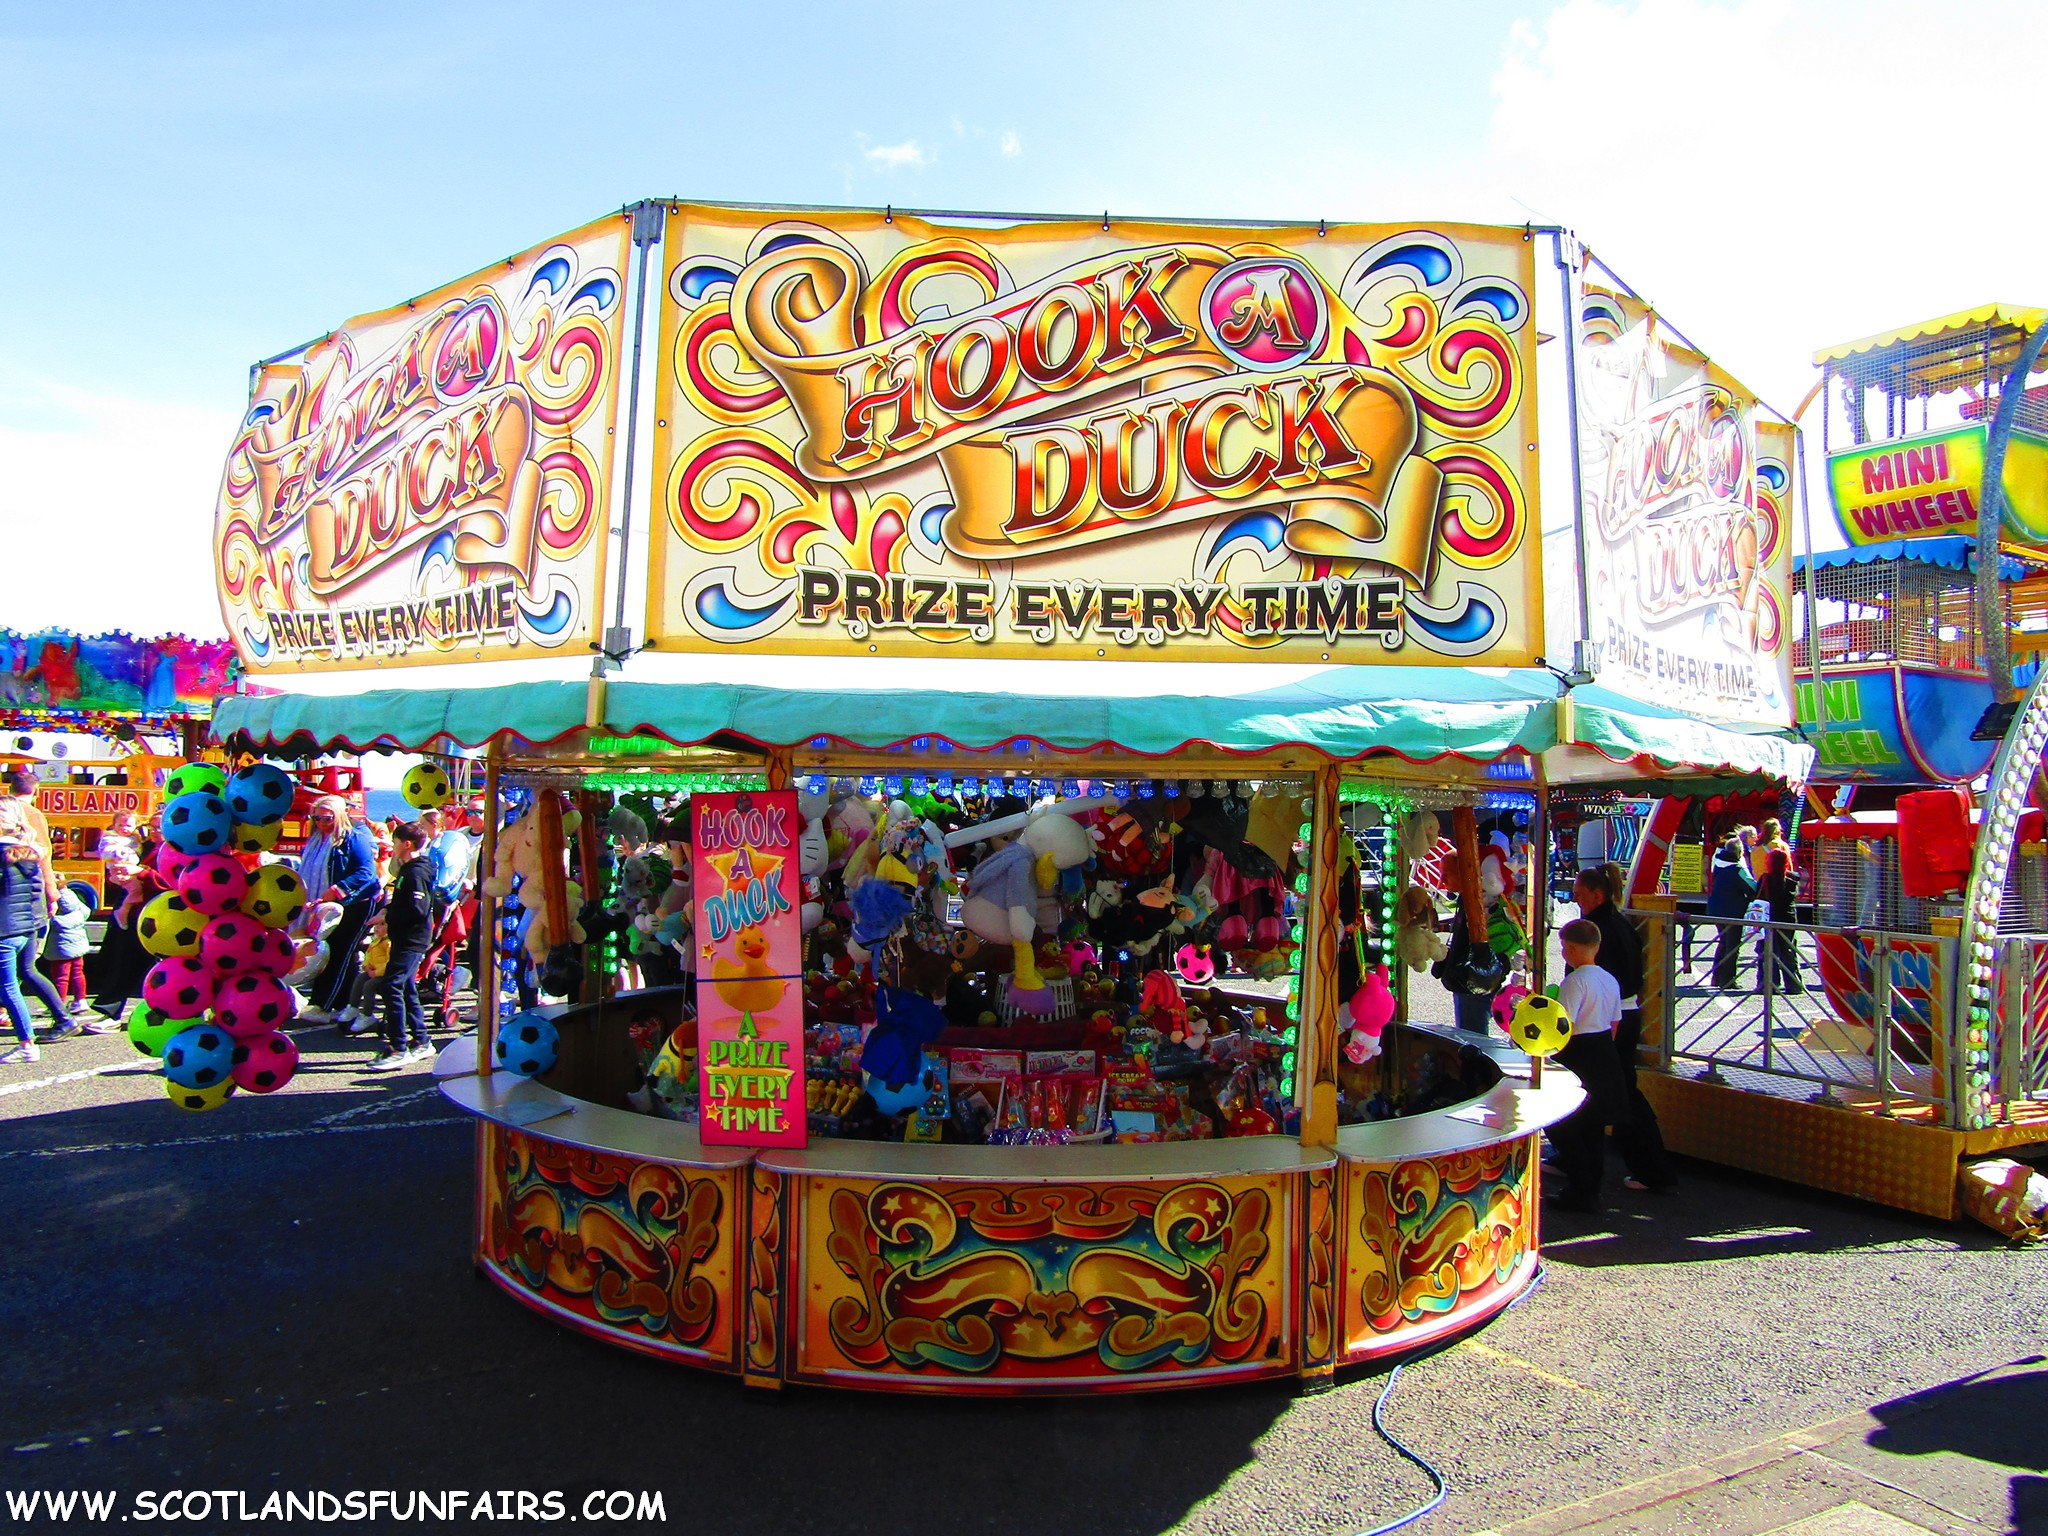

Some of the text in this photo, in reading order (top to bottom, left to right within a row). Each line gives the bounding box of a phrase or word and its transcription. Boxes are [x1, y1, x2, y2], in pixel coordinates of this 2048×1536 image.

[832, 248, 1309, 470] HOOK A
[267, 305, 489, 534] HOOK A
[329, 386, 511, 580] DUCK
[1000, 368, 1372, 545] DUCK
[1860, 442, 1950, 496] MINI
[1849, 486, 1978, 539] WHEEL
[1645, 506, 1742, 613] DUCK
[267, 579, 517, 650] PRIZE EVERY TIME
[798, 568, 1402, 645] PRIZE EVERY TIME
[1607, 616, 1758, 698] PRIZE EVERY TIME
[1814, 730, 1900, 765] EEL
[41, 790, 141, 813] ISLAND
[699, 808, 791, 849] HOOK
[729, 847, 754, 880] A
[703, 869, 791, 941] DUCK
[738, 1009, 758, 1037] A
[709, 1040, 789, 1068] PRIZE
[708, 1073, 792, 1100] EVERY
[717, 1106, 784, 1133] TIME
